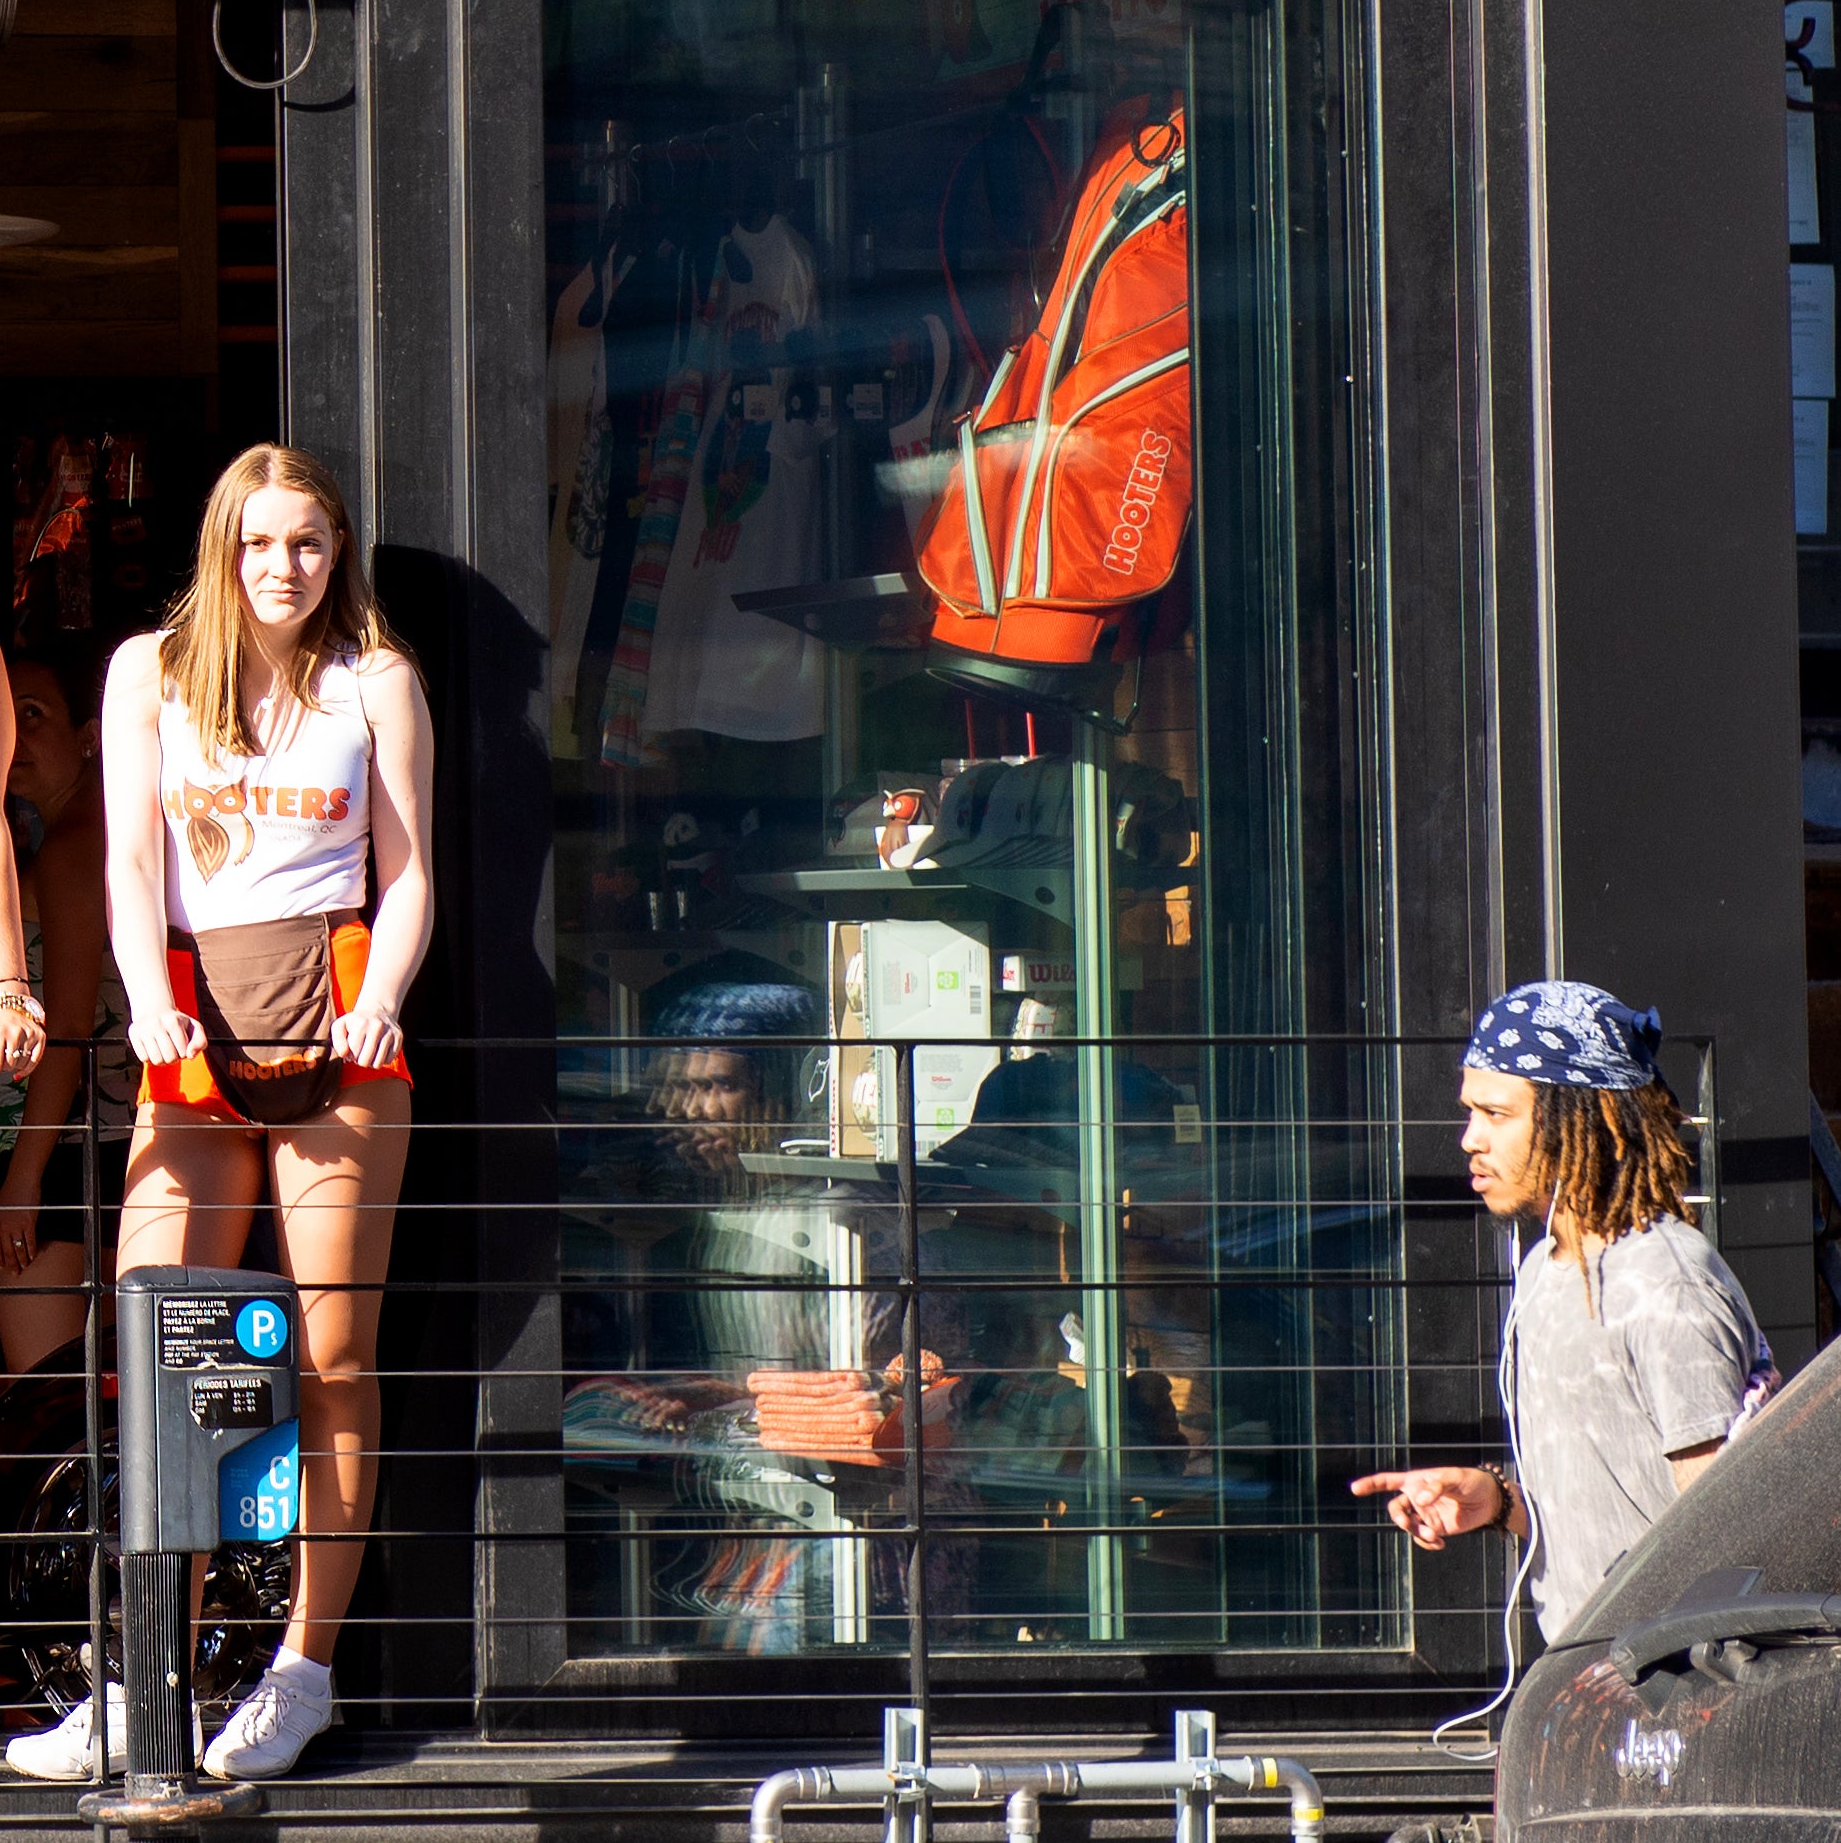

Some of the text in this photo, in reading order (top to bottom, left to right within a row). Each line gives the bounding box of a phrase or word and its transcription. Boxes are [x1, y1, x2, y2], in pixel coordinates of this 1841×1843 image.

[1103, 429, 1172, 576] HOOTERS
[163, 786, 351, 821] HOOTERS
[252, 1309, 276, 1348] P
[269, 1455, 290, 1490] C
[239, 1495, 290, 1530] 851
[1616, 1718, 1682, 1786] Jeep
